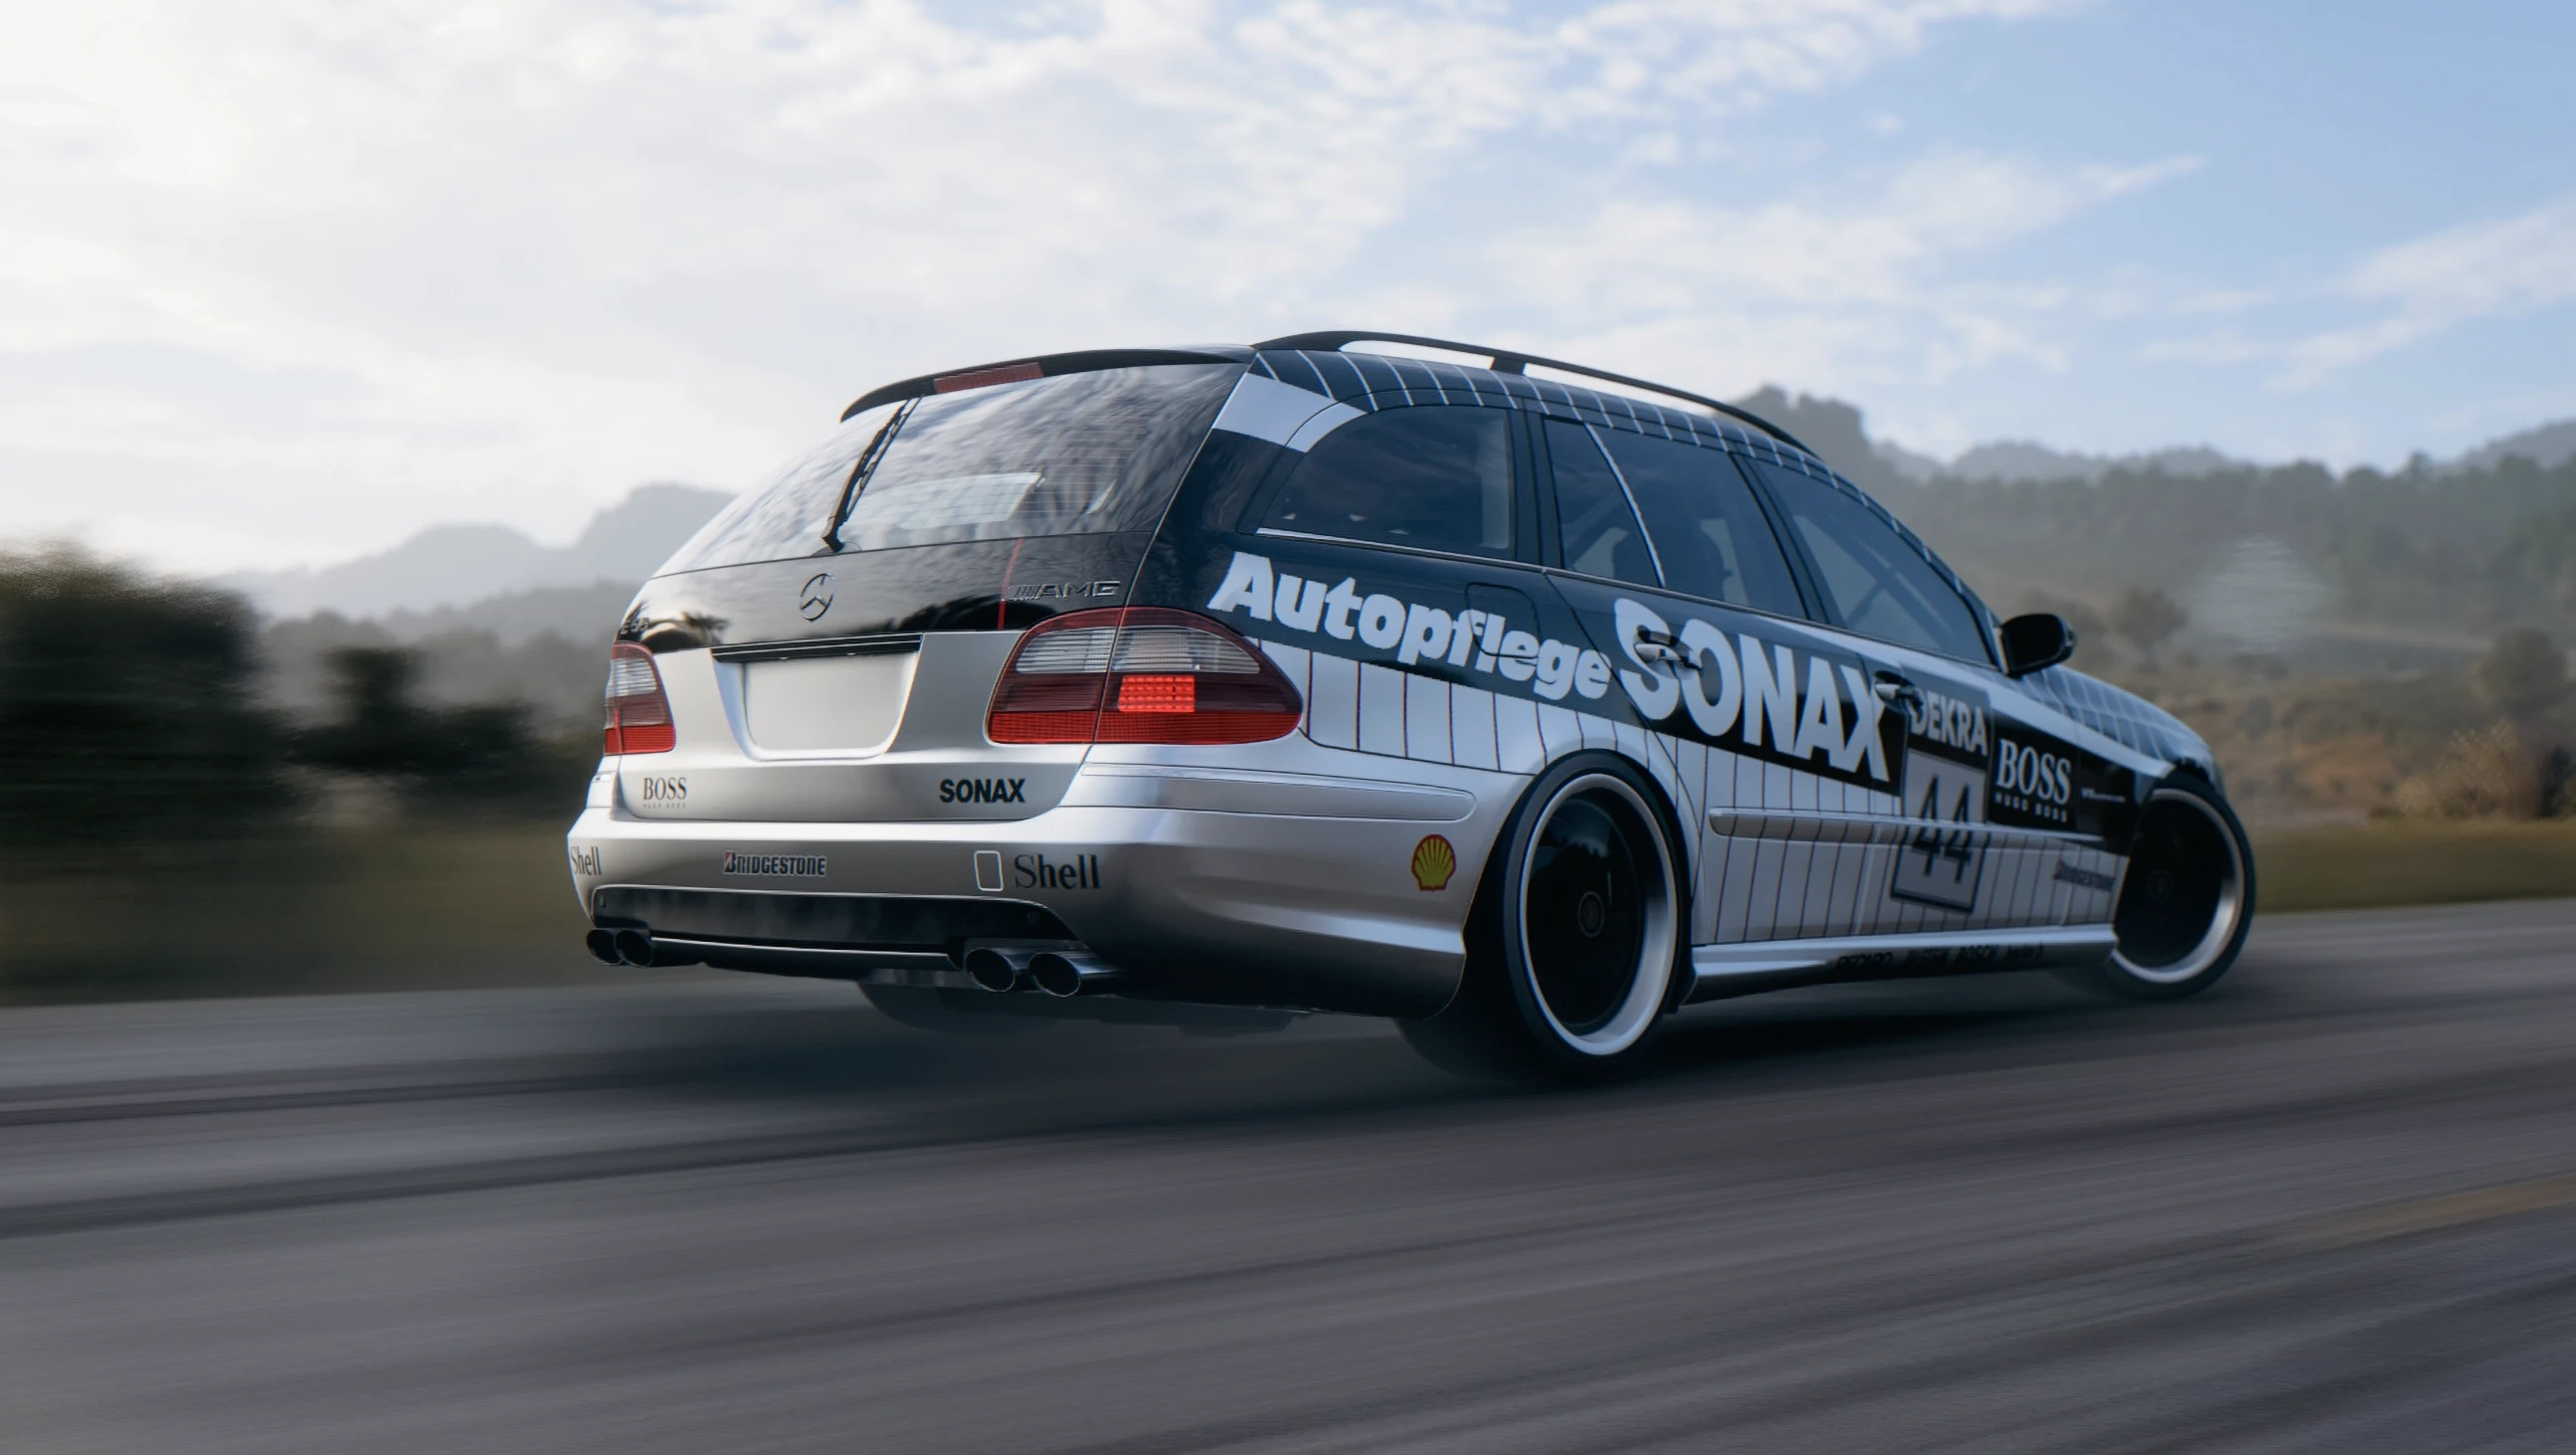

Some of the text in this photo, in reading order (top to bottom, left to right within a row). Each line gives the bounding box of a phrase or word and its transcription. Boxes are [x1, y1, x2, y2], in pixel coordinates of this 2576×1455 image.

[1034, 580, 1121, 600] AMG
[1206, 551, 1890, 782] Autopflege SONAX
[1907, 688, 1988, 756] DEKRA
[1995, 738, 2072, 805] BOSS
[643, 777, 687, 801] BOSS
[939, 779, 1026, 804] SONAX
[1911, 774, 1972, 885] 44
[570, 846, 602, 875] Shell
[723, 850, 827, 876] BRIDGESTONE
[1014, 853, 1101, 889] Shell
